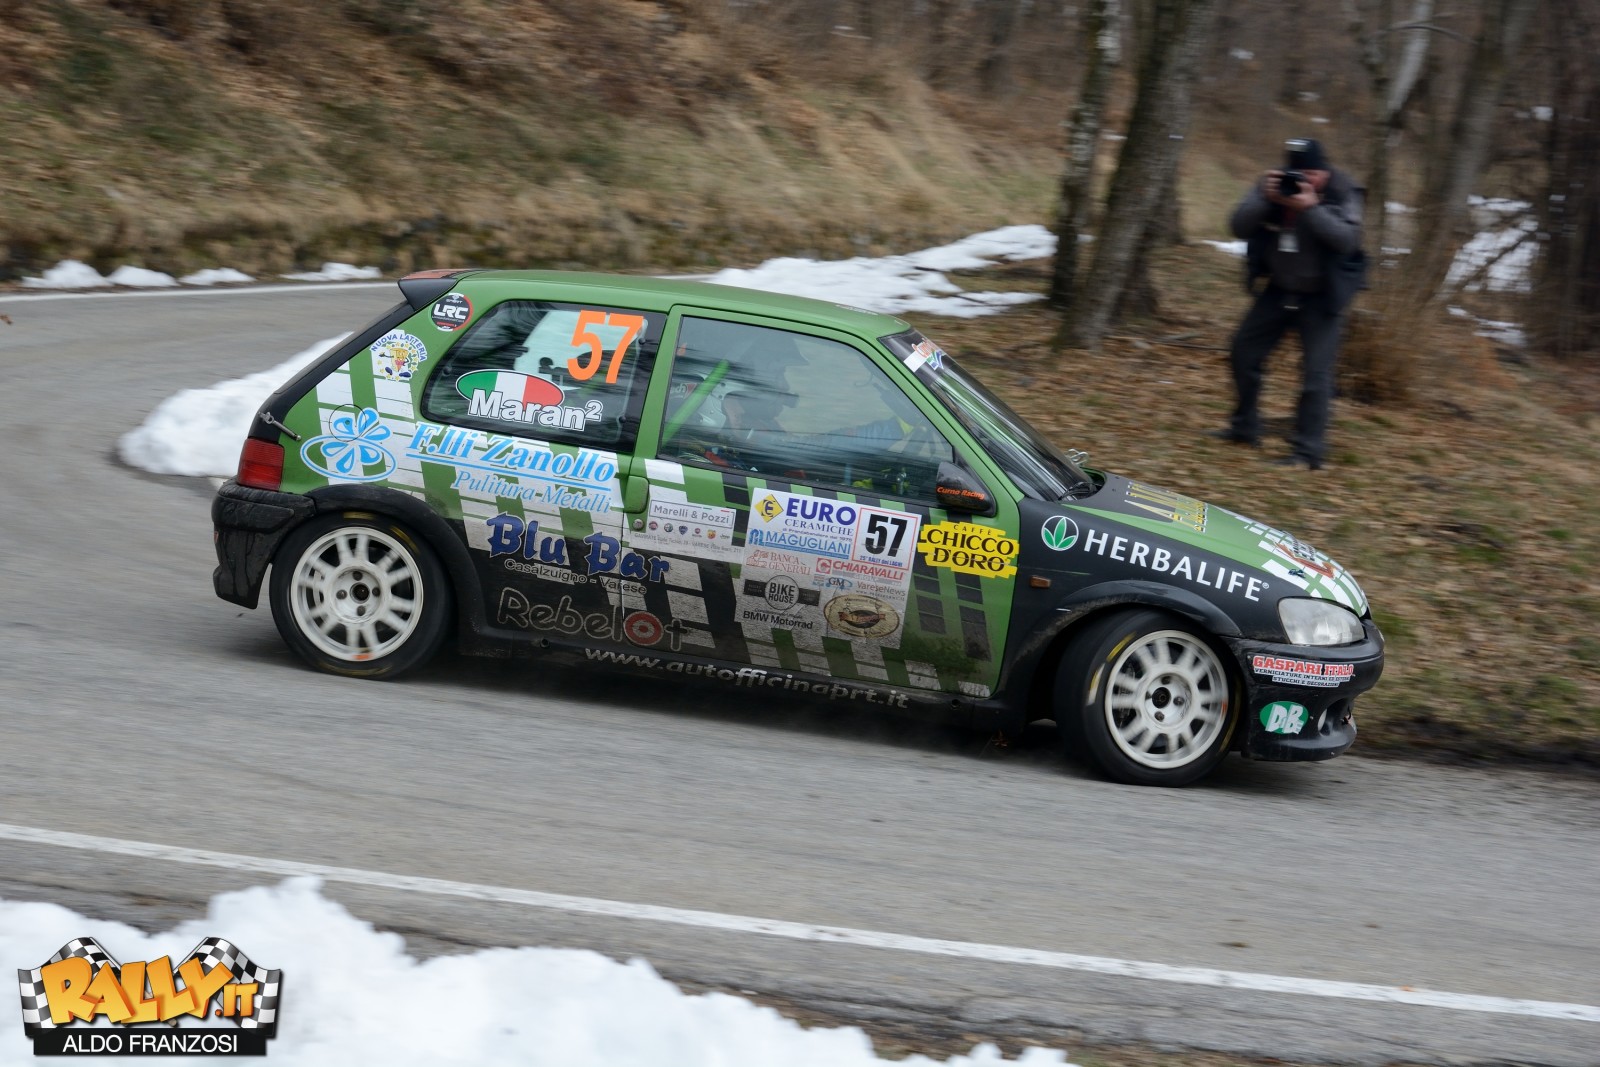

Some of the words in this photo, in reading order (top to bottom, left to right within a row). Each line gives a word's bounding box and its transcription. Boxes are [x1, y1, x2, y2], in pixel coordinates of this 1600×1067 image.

[433, 303, 469, 320] LRC
[371, 334, 398, 352] NUOVA
[400, 333, 427, 361] LATTERIA
[567, 309, 644, 384] 57
[406, 423, 479, 459] F.lli
[480, 436, 615, 483] Zanollo
[453, 470, 536, 501] Pulitura
[541, 485, 612, 514] Metalli
[961, 489, 985, 500] Racing
[654, 504, 688, 518] Marelli
[691, 511, 698, 519] &
[701, 512, 730, 524] Pozzi
[786, 497, 857, 526] EURO
[784, 518, 855, 537] CERAMICHE
[865, 513, 908, 558] 57
[953, 524, 992, 536] CAFFÈ
[486, 512, 567, 566] Blu
[584, 532, 670, 582] Bar
[766, 530, 851, 555] MAGUGLIANI
[927, 529, 1014, 556] CHICCO
[770, 551, 800, 565] BANCA
[933, 547, 1005, 572] D'ORO
[504, 558, 588, 585] Casalzuigno
[600, 576, 648, 596] Varese
[769, 562, 812, 576] GENERALI
[832, 561, 905, 581] CHIARAVALLI
[769, 582, 796, 597] BIKE
[828, 576, 845, 586] GM
[857, 580, 906, 597] VareseNews
[768, 593, 794, 605] HOUSE
[743, 610, 769, 622] BMW
[770, 614, 814, 630] Motorrad
[1253, 655, 1323, 675] GASPARI
[1324, 664, 1354, 676] ITALO
[1254, 667, 1302, 678] VERNICIATURE
[585, 648, 912, 710] www.autofficinaprt.it
